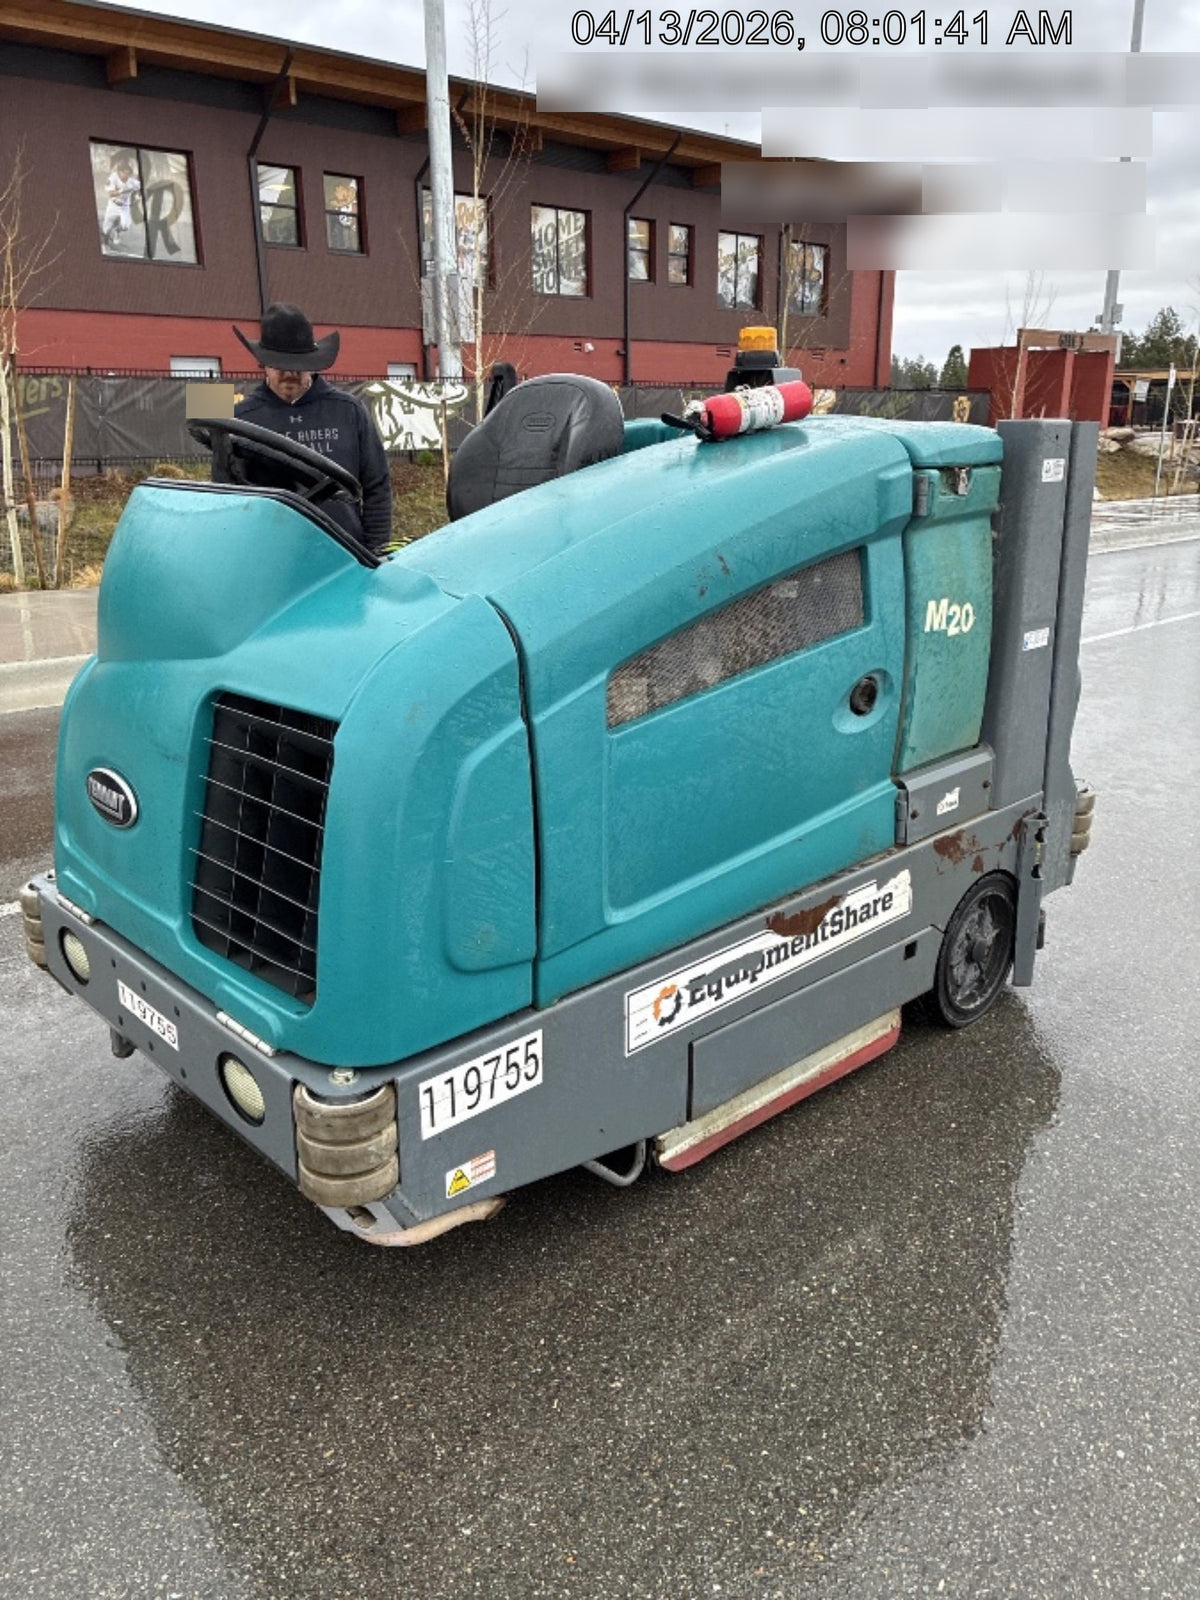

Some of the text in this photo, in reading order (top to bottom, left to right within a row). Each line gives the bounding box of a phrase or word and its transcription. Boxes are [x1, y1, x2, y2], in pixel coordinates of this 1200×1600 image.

[532, 213, 584, 254] HOME
[298, 428, 338, 441] RIDERS
[924, 598, 976, 637] M20
[120, 986, 177, 1044] 119755
[423, 1038, 540, 1128] 119755
